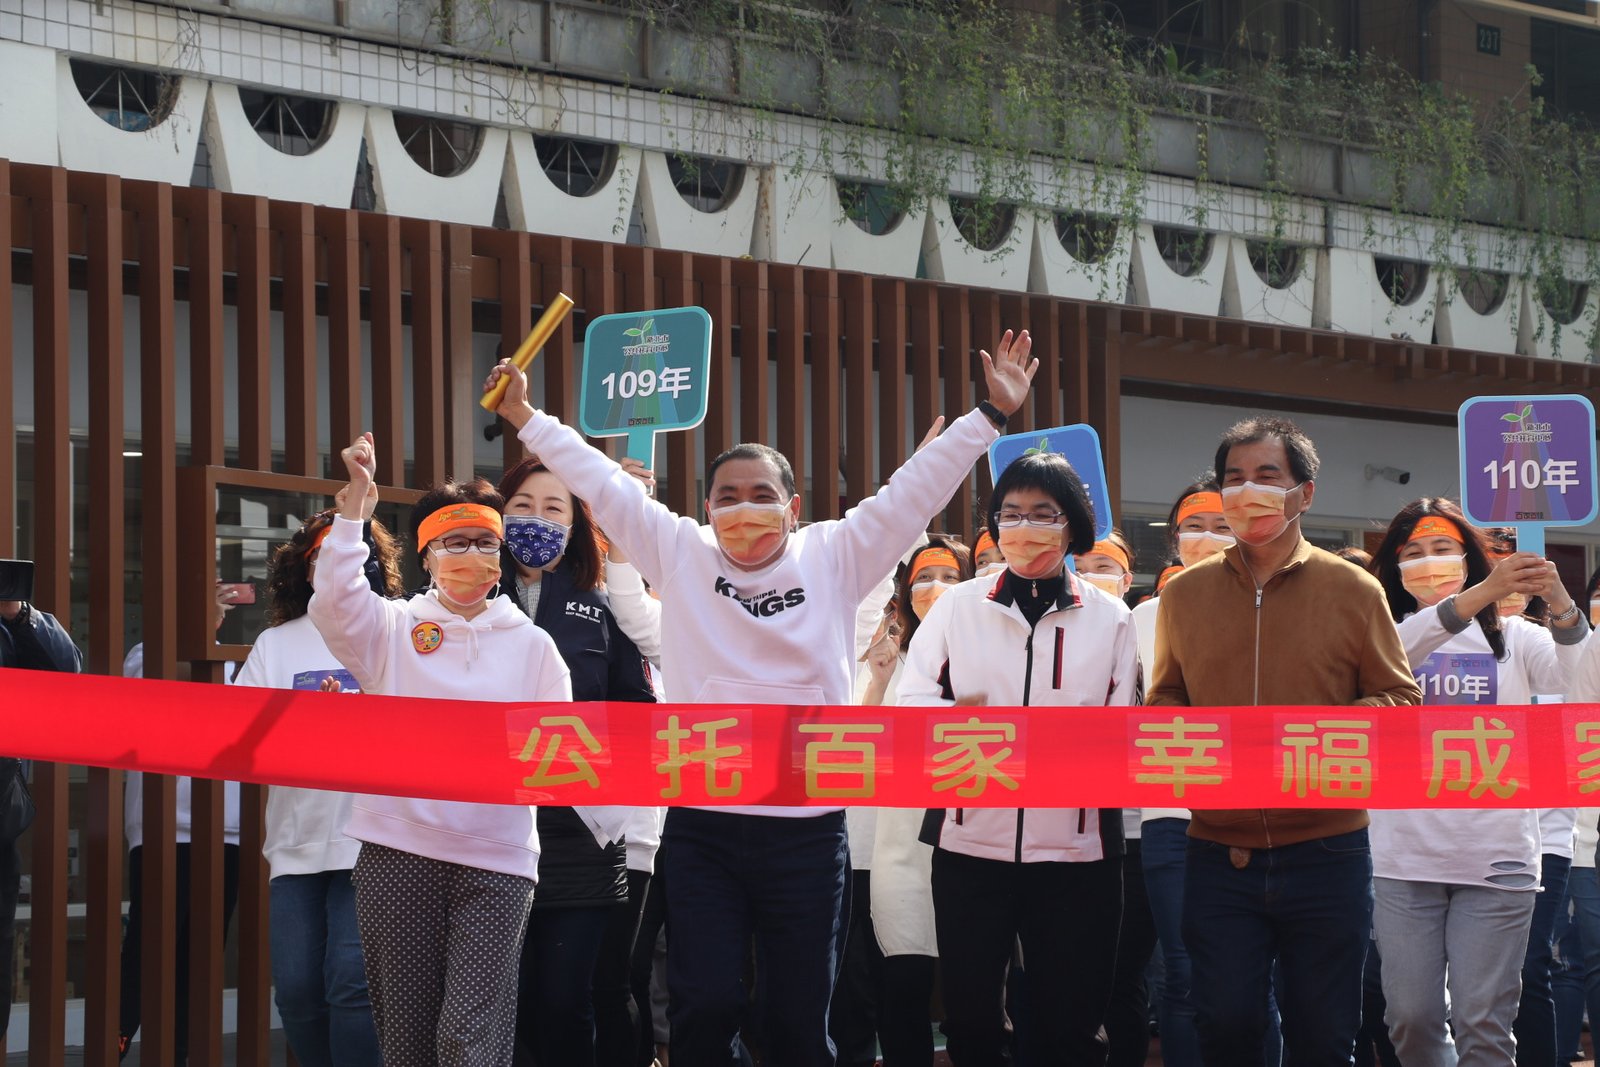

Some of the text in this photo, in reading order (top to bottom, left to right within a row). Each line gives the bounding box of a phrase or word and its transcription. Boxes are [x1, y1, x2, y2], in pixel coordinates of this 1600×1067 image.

[1480, 28, 1499, 51] 237
[602, 367, 692, 399] 109年
[1483, 459, 1580, 494] 110年
[565, 601, 603, 618] KMT
[1416, 674, 1490, 701] 110年
[519, 715, 1020, 799] 公托百家
